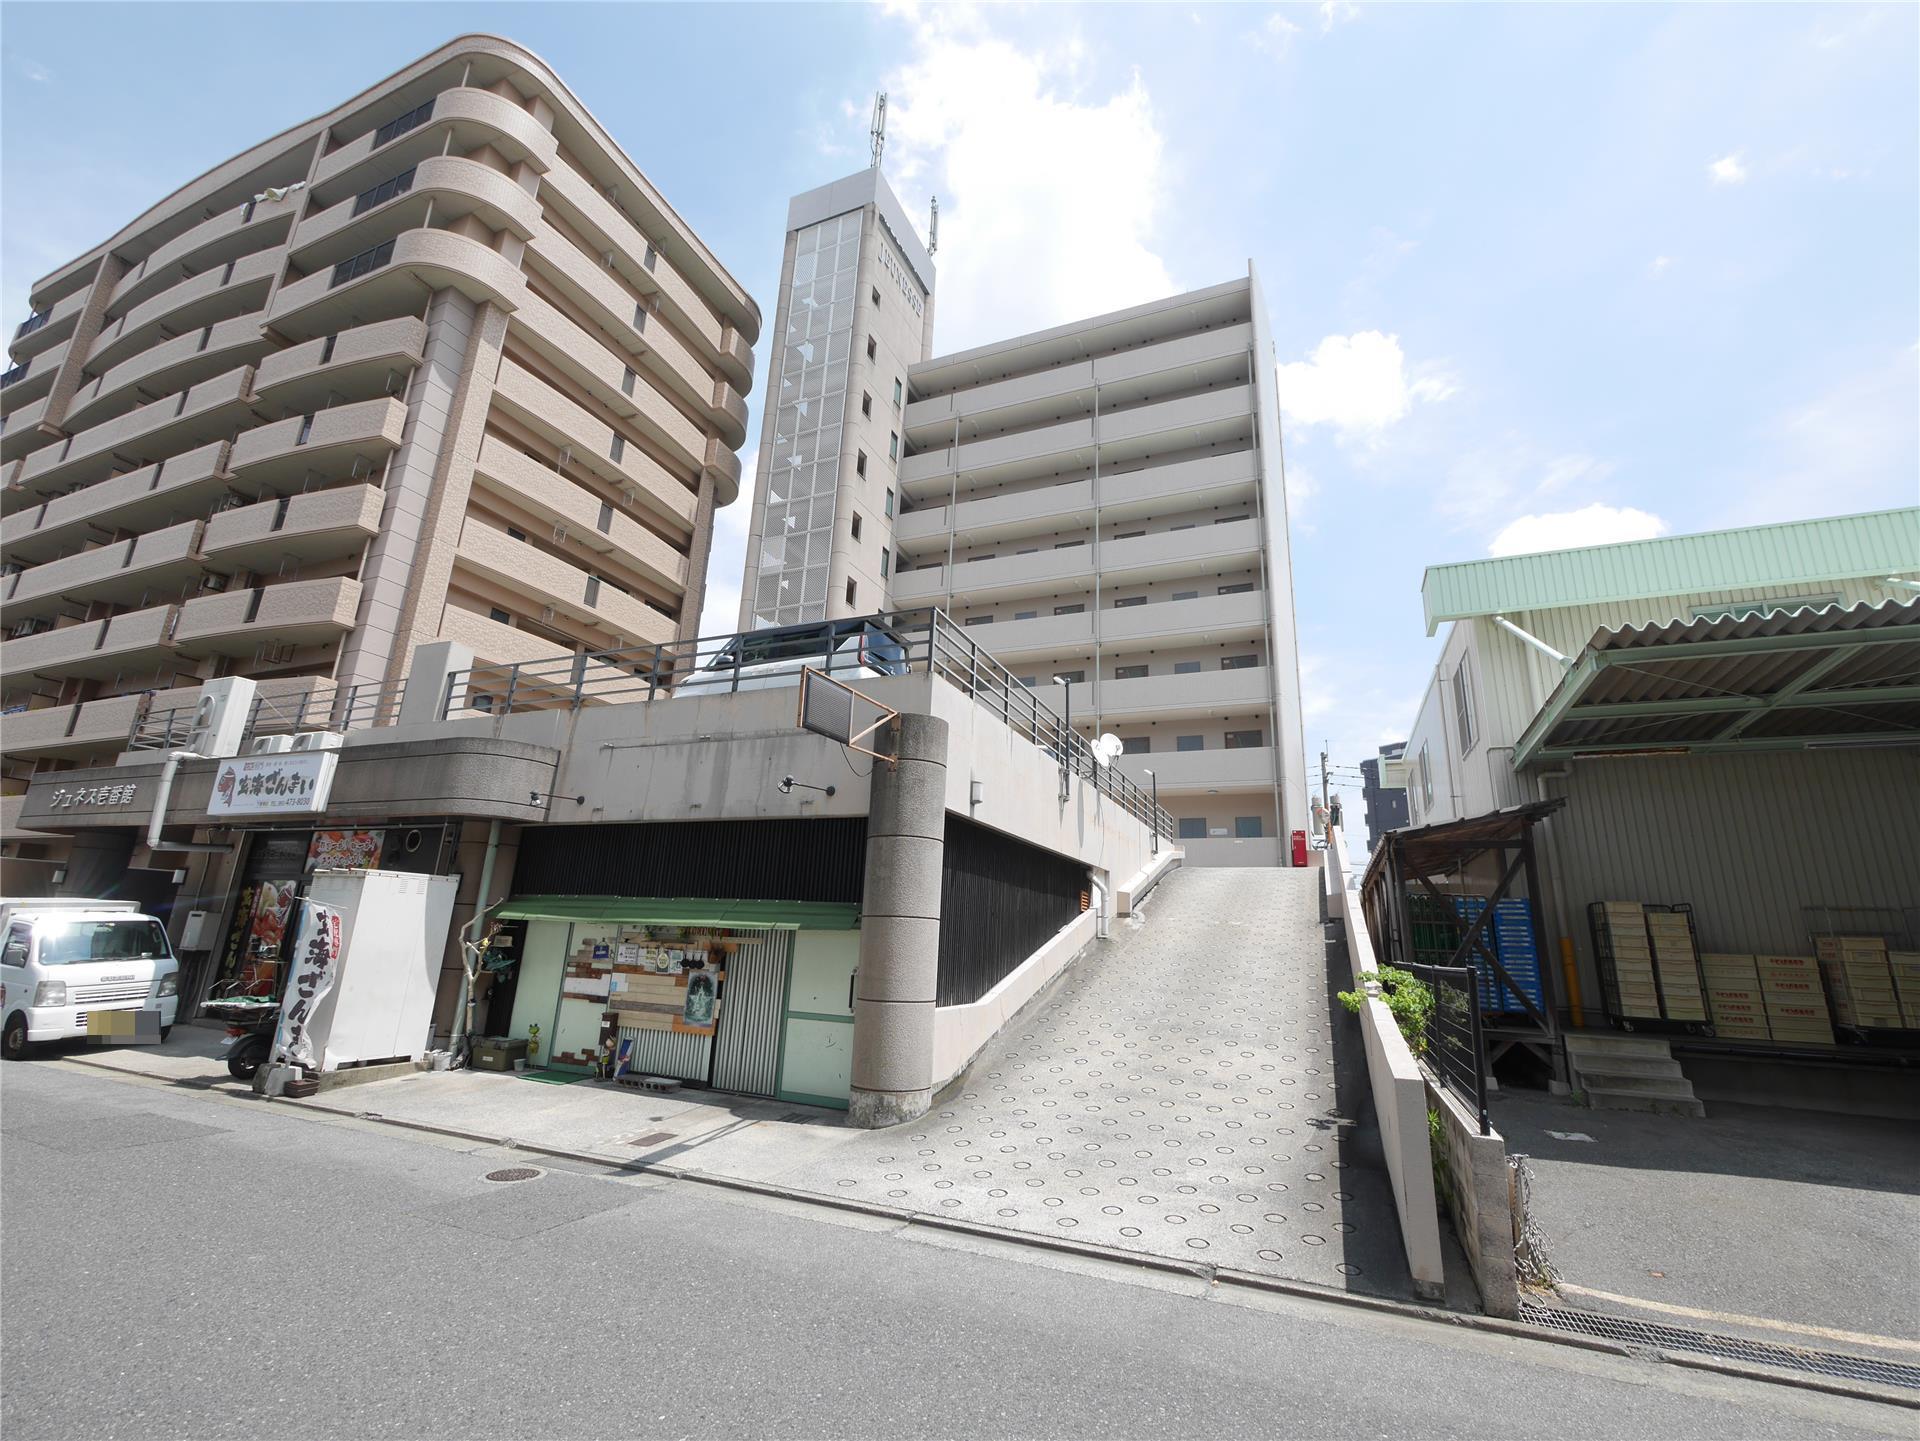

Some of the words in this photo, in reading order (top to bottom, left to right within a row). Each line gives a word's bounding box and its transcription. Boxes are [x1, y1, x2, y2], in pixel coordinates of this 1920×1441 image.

[878, 242, 921, 318] JEUNESSE
[50, 783, 136, 807] ジュネス壱番館
[237, 768, 314, 796] 玄海ざんまい
